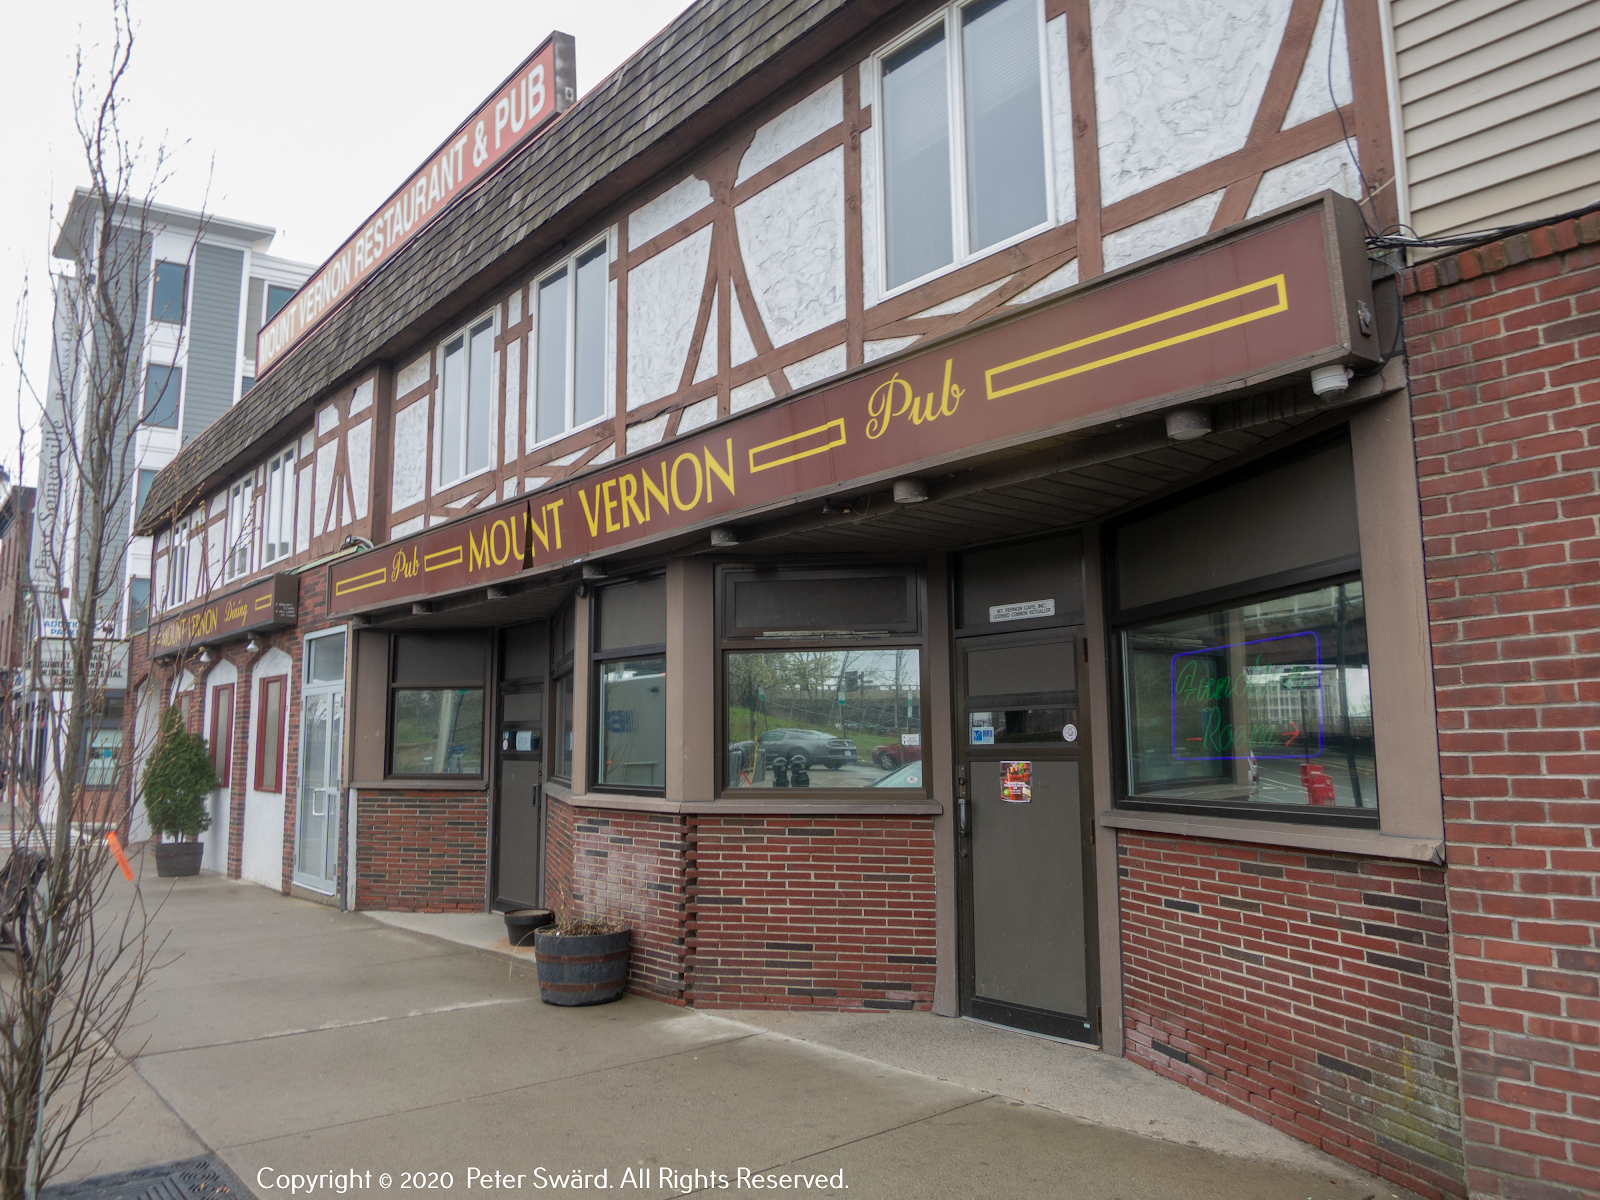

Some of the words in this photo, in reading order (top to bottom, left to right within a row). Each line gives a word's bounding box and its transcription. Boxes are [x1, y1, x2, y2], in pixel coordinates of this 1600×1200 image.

[258, 305, 298, 368] MOUNT
[299, 249, 352, 329] VERNON
[353, 133, 468, 279] RESTAURANT
[472, 120, 489, 168] &
[495, 63, 546, 150] PUB
[391, 546, 420, 582] Pub
[469, 499, 564, 573] MOUNT
[578, 438, 736, 538] VERNON
[866, 358, 966, 440] Pub
[161, 616, 187, 648] MOUNT
[224, 598, 249, 627] Dining
[1005, 605, 1023, 613] VERNON
[1203, 705, 1279, 753] Room
